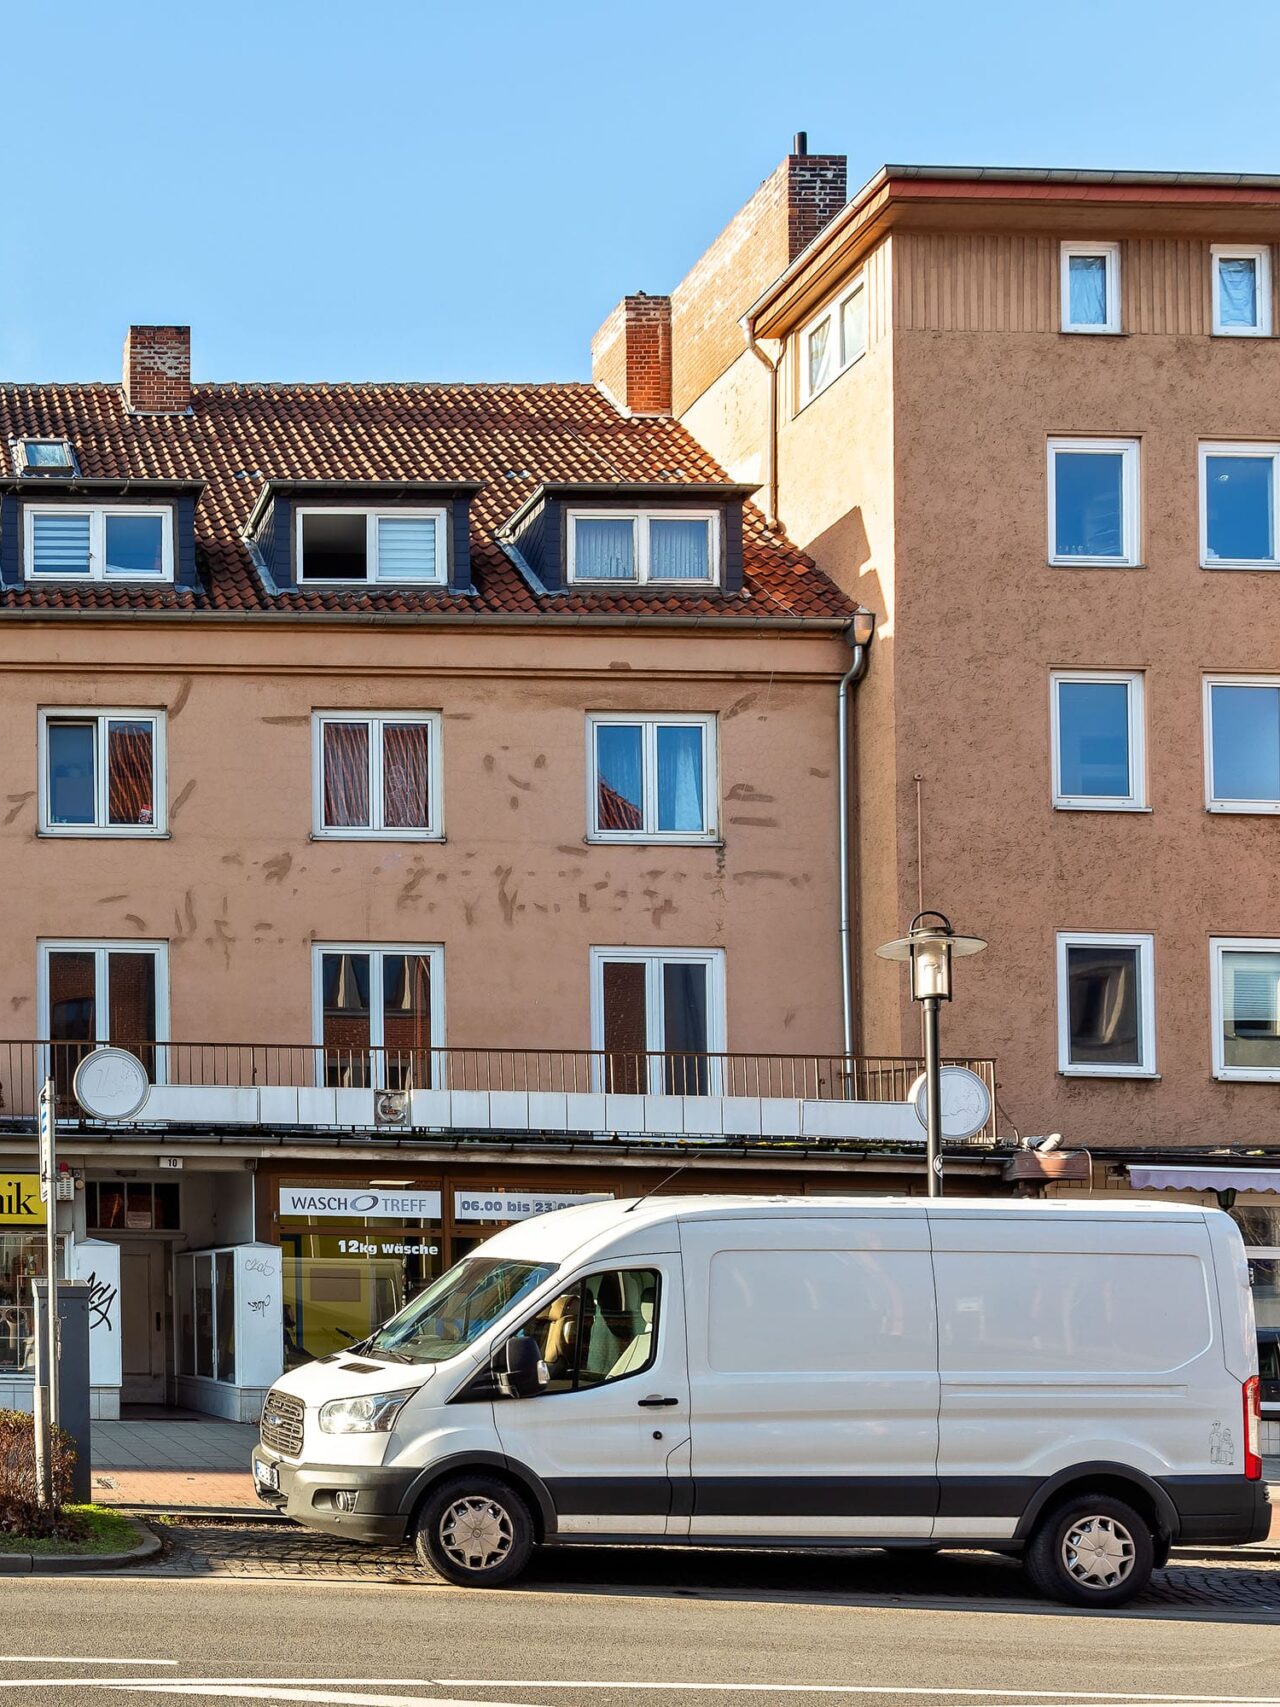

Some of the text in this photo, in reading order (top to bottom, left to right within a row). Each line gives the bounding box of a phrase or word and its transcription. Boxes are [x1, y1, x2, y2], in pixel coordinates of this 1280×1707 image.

[167, 1158, 178, 1168] 10
[291, 1196, 427, 1212] WASCH TREFF
[461, 1200, 503, 1212] 06.00
[507, 1201, 531, 1213] bis
[338, 1239, 439, 1255] 12kg Wäsche
